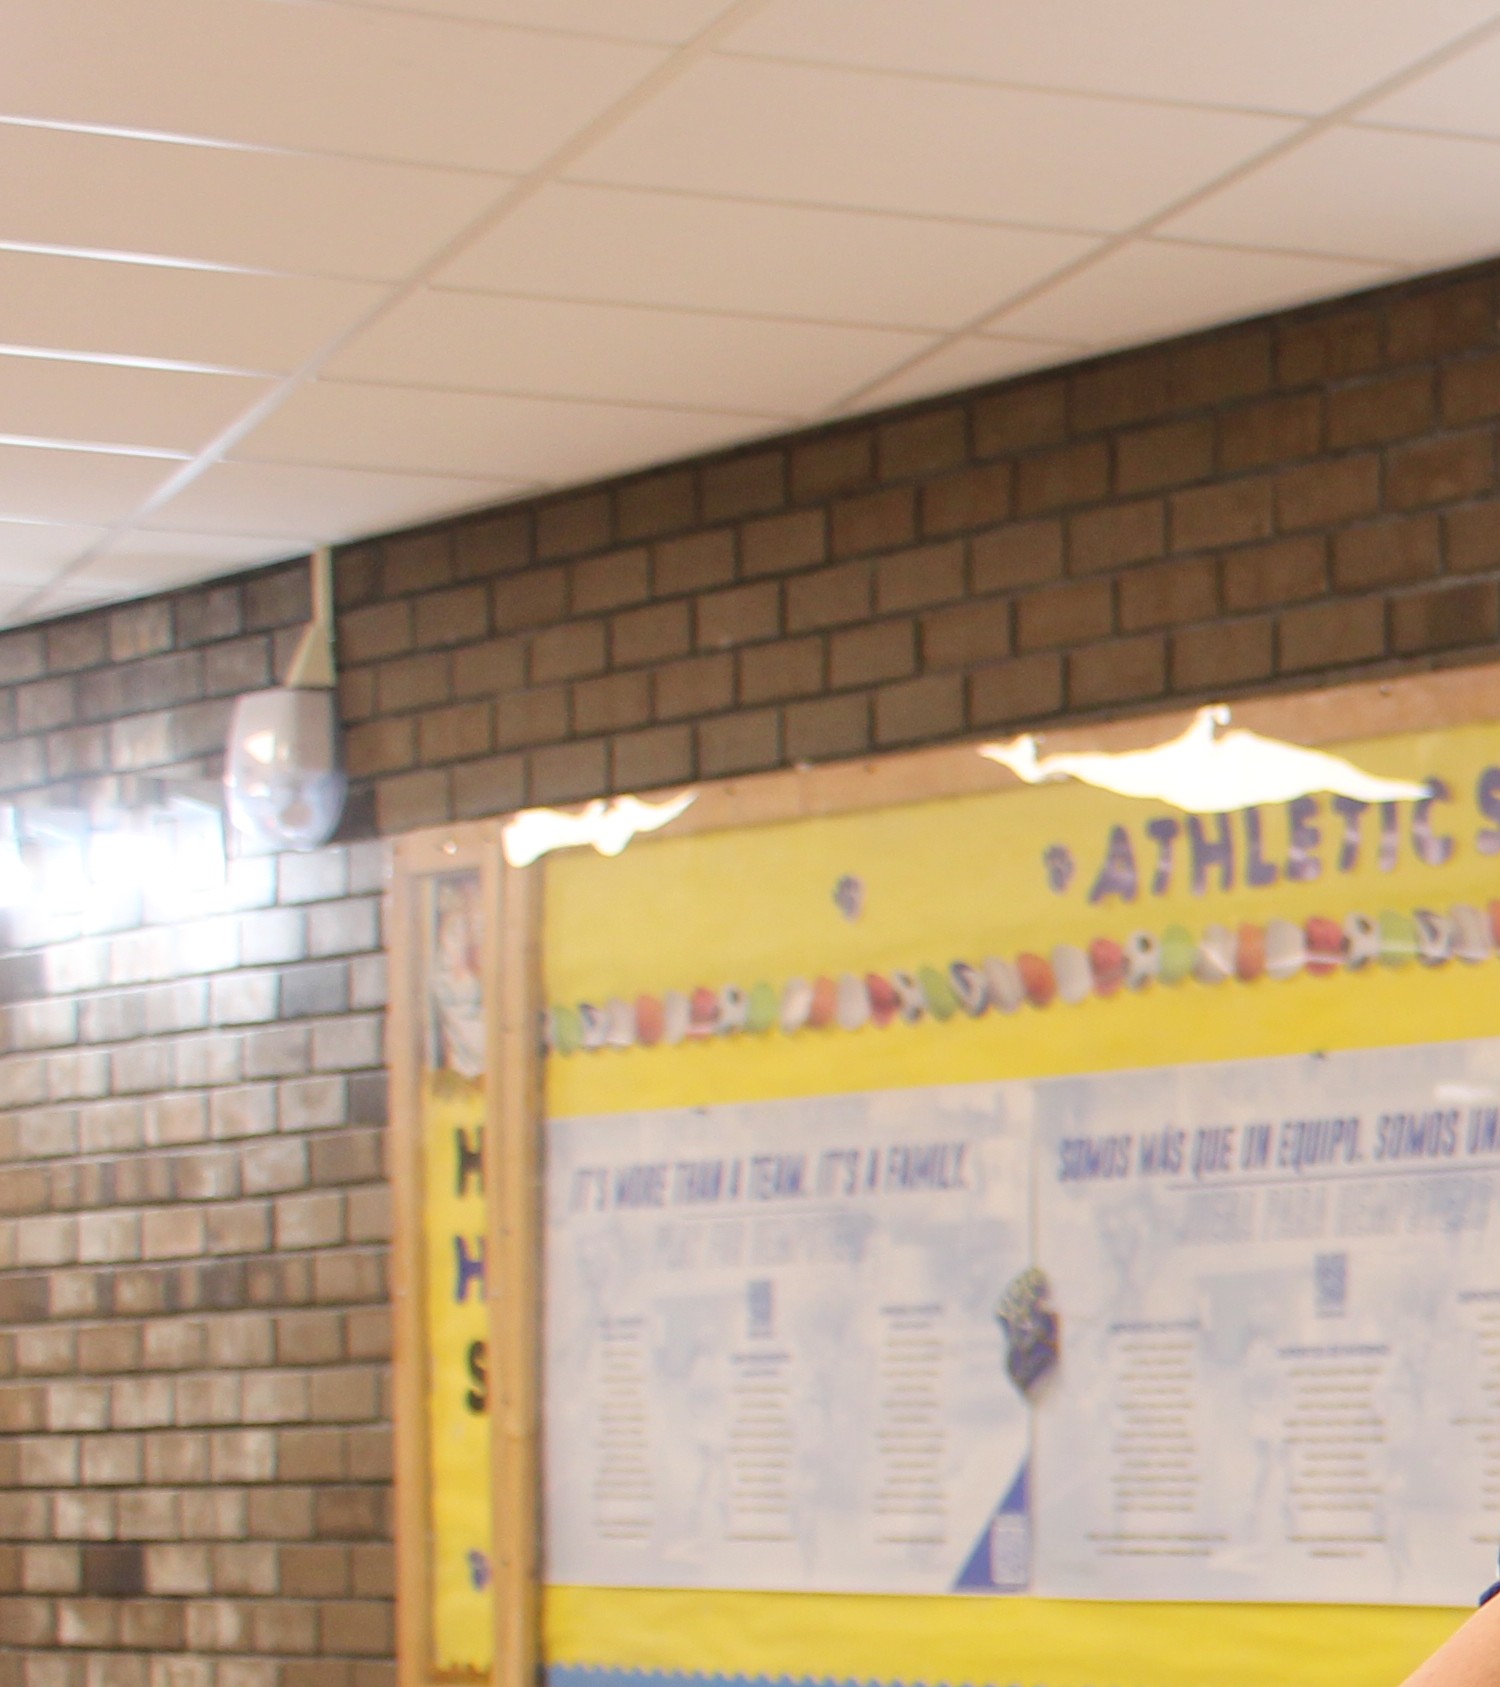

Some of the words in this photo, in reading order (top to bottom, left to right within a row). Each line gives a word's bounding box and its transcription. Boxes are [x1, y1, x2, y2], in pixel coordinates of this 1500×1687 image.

[1057, 1132, 1132, 1182] SOMOS
[1191, 1125, 1236, 1180] QUE
[1239, 1121, 1272, 1170] UN
[1372, 1109, 1460, 1162] SOMOS
